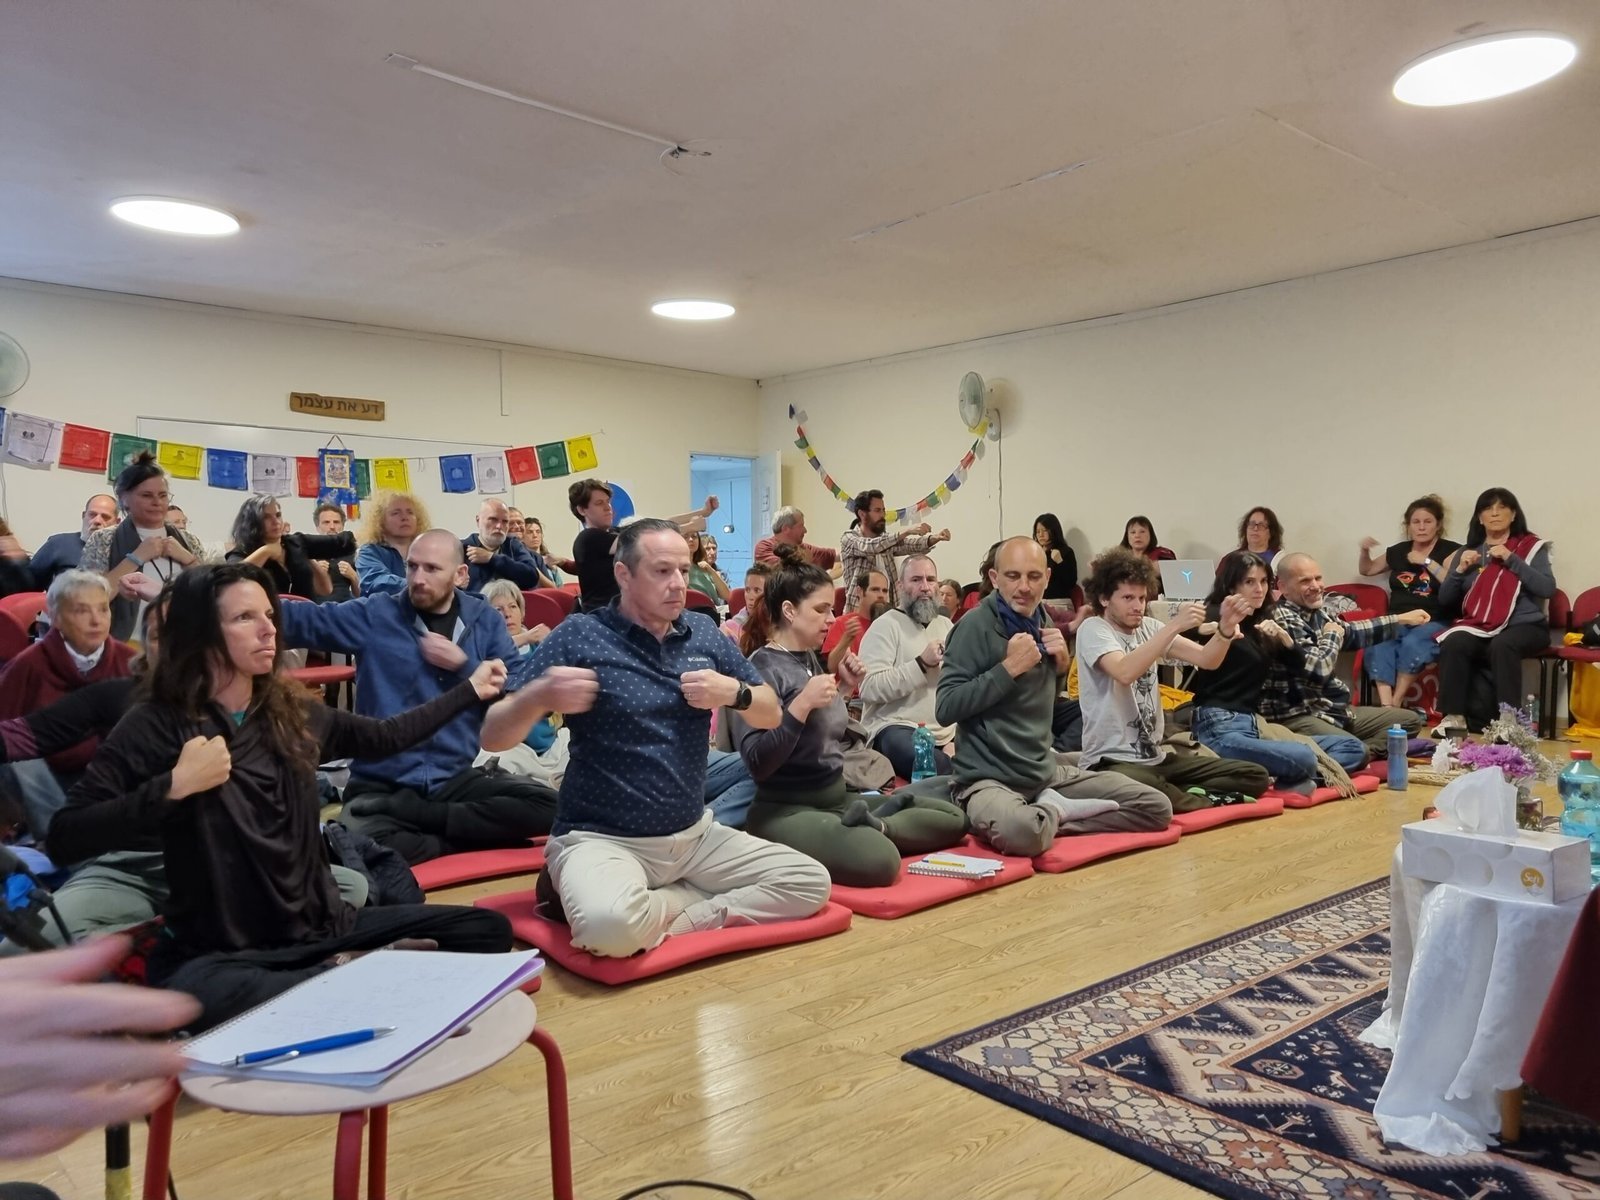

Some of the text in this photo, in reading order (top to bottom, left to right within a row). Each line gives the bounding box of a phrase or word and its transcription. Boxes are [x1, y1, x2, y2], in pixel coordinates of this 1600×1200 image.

[293, 395, 379, 414] דע את עצמך
